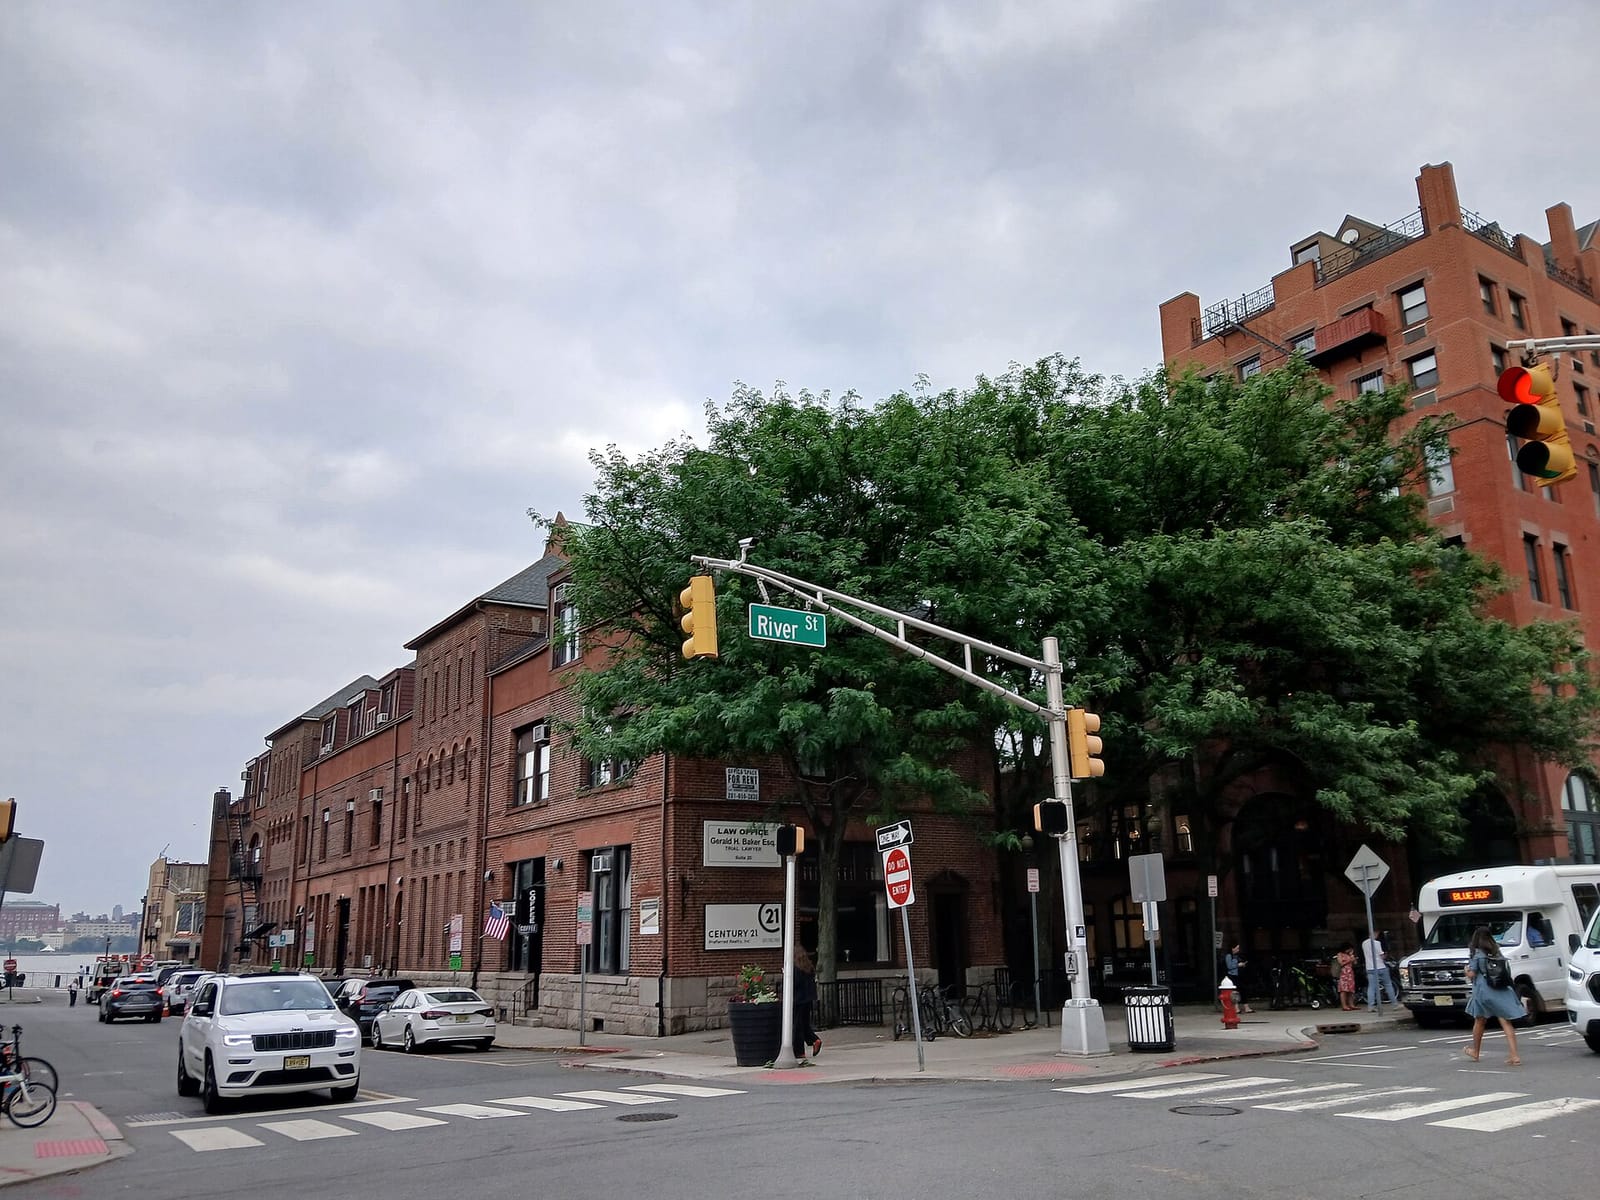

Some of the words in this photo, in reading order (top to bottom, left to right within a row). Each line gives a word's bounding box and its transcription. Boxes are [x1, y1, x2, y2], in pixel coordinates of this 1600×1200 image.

[758, 615, 798, 639] River
[805, 615, 818, 632] St
[728, 774, 740, 784] FOR
[742, 775, 758, 785] RENT
[710, 837, 732, 845] Gerald
[742, 838, 760, 846] Baker
[880, 834, 891, 844] ONE
[891, 830, 900, 840] WAY
[888, 861, 896, 871] DO
[897, 858, 906, 868] NOT
[892, 884, 907, 895] ENTER
[1452, 891, 1474, 901] BLUE
[1473, 890, 1490, 900] HOP
[708, 930, 748, 938] CENTURY
[750, 929, 758, 938] 21
